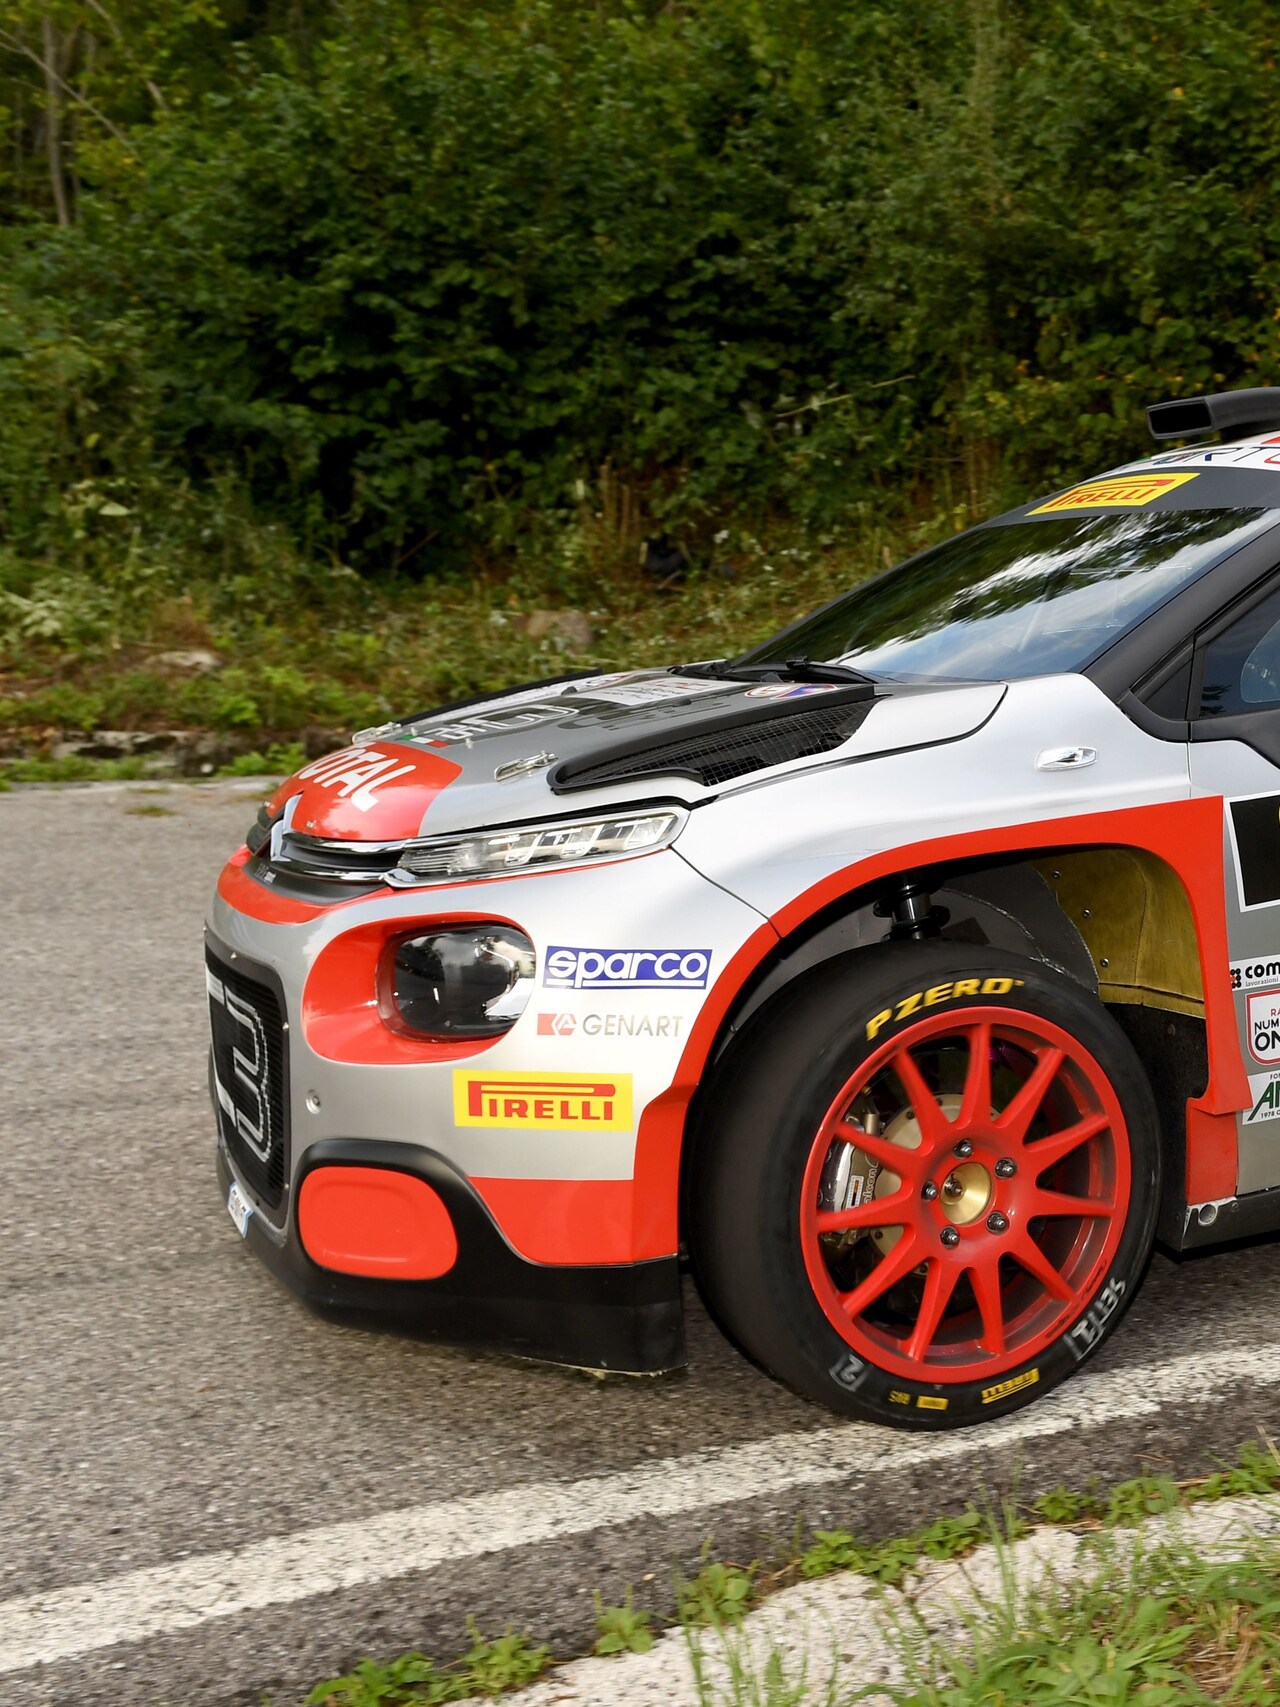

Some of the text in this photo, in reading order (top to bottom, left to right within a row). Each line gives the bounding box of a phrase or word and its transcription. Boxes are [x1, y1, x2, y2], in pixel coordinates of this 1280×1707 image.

[1045, 479, 1176, 509] PIRELLI
[548, 950, 708, 987] sparco
[1245, 976, 1279, 987] lavorazioni
[582, 1013, 683, 1037] GENART
[467, 1080, 617, 1121] PIRELLI
[1261, 1110, 1275, 1119] 1978
